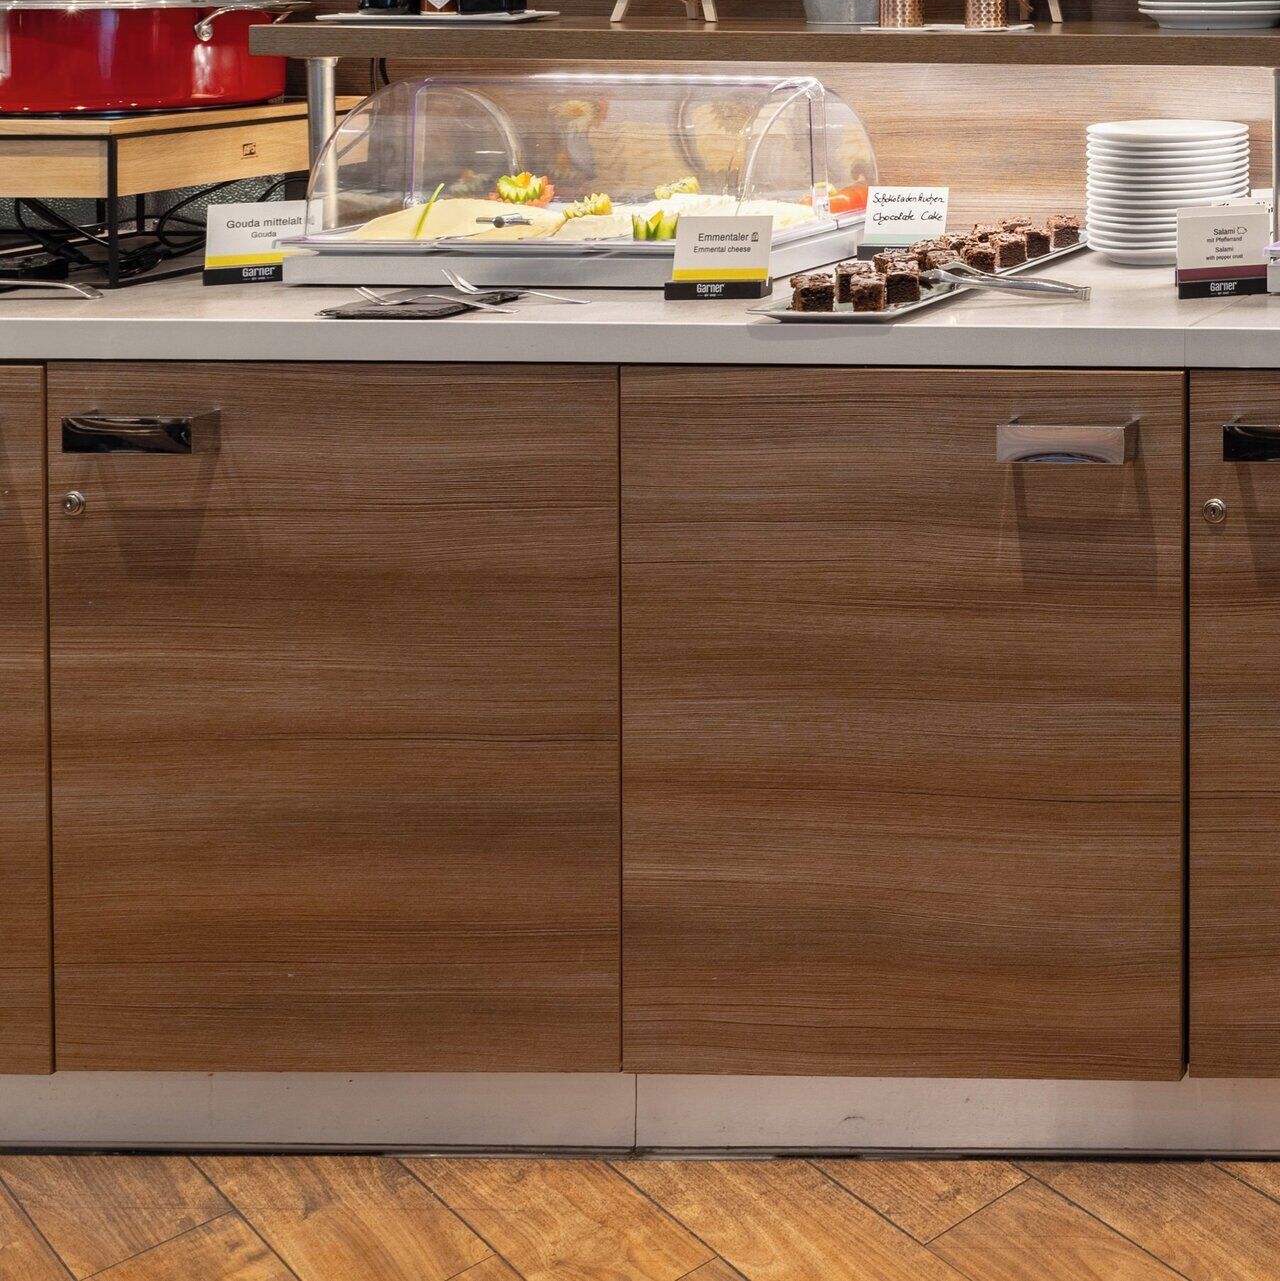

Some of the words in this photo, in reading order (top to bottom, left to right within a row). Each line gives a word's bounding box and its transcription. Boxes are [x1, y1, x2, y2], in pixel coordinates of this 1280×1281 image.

[921, 211, 943, 221] Cake
[226, 220, 260, 229] Gouda
[263, 217, 303, 227] mittelalt
[251, 231, 277, 239] Gouda
[698, 233, 749, 241] Emmentaler
[242, 267, 275, 277] Garner
[696, 283, 725, 293] Garner
[1210, 280, 1237, 291] Garner
